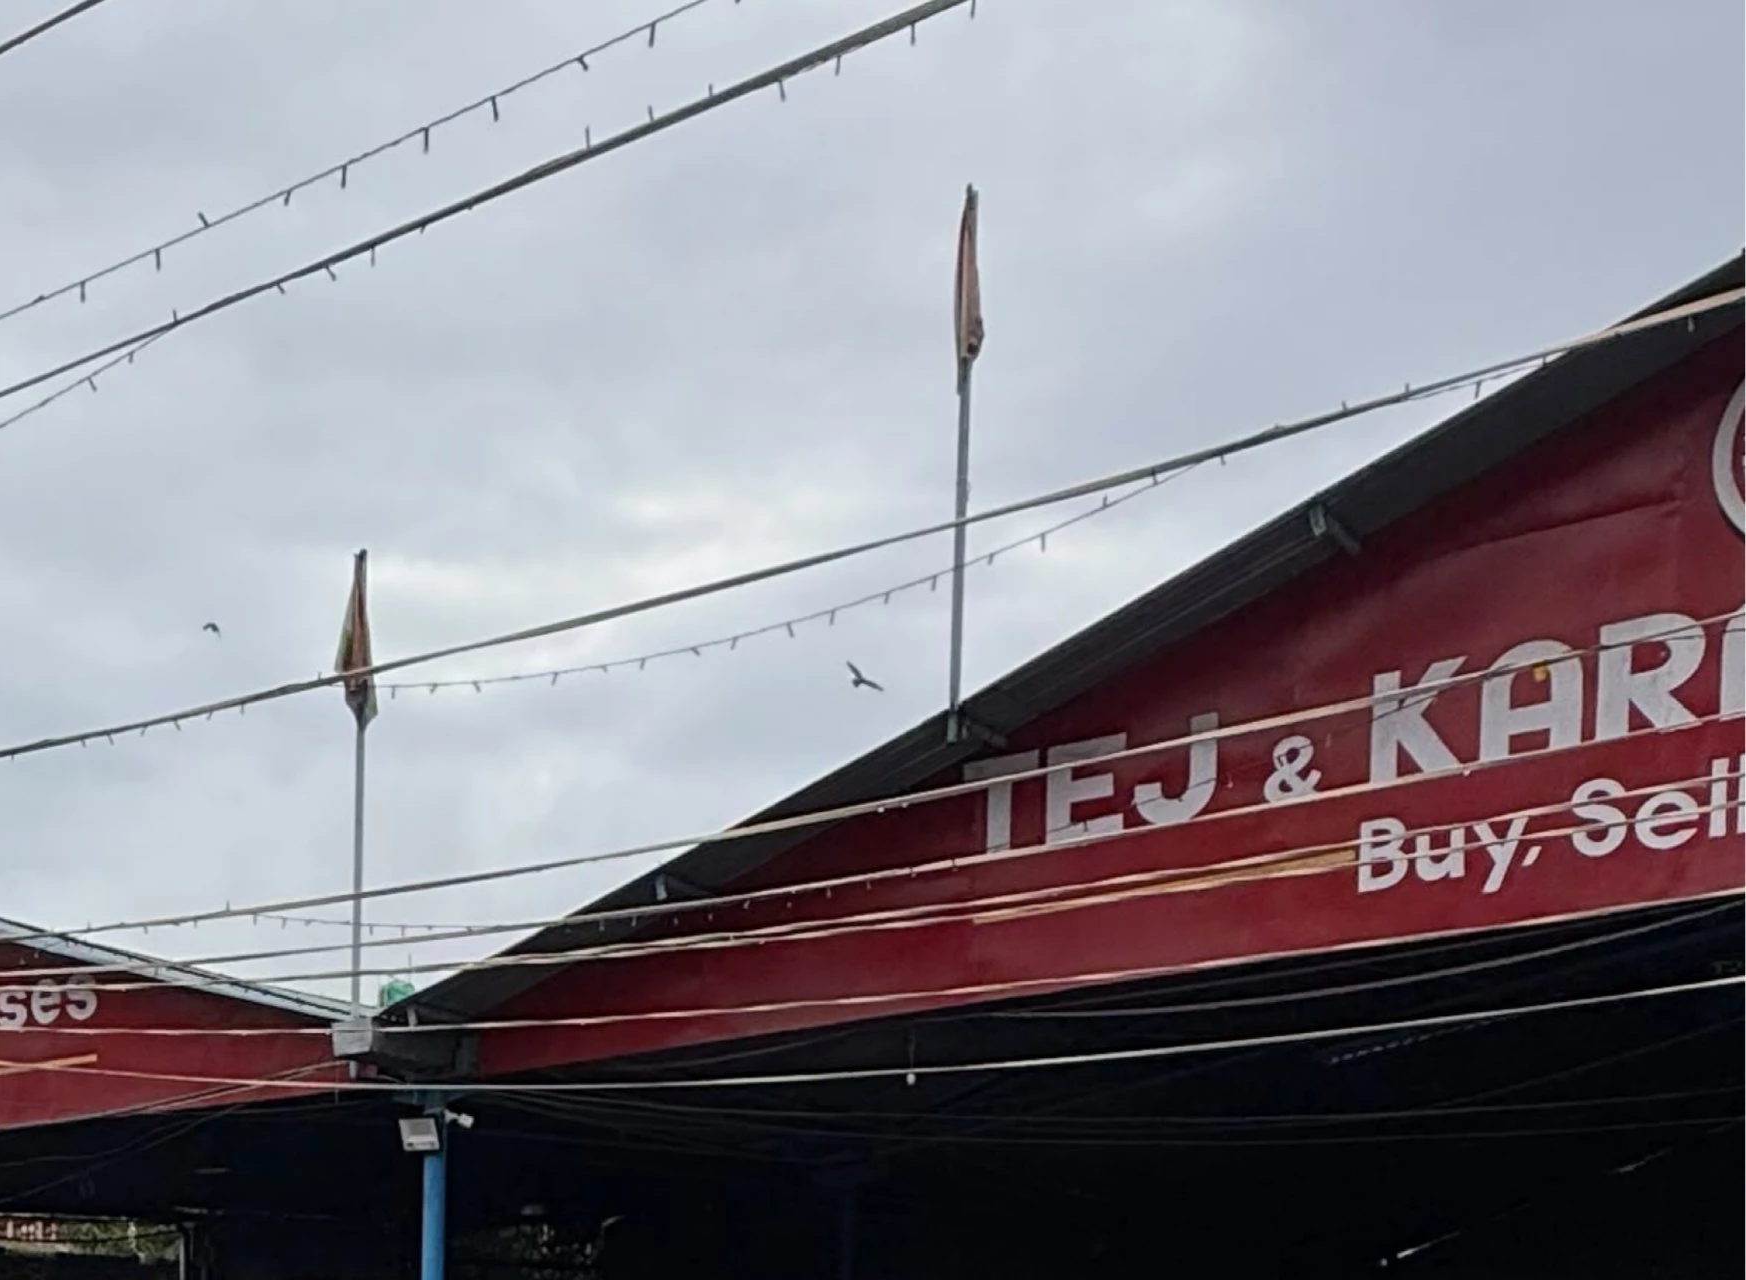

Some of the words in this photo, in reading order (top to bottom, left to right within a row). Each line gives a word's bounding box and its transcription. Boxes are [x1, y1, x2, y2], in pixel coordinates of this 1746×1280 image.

[963, 712, 1219, 855] TEJ
[1263, 734, 1322, 804] &
[1357, 816, 1543, 894] Buy,
